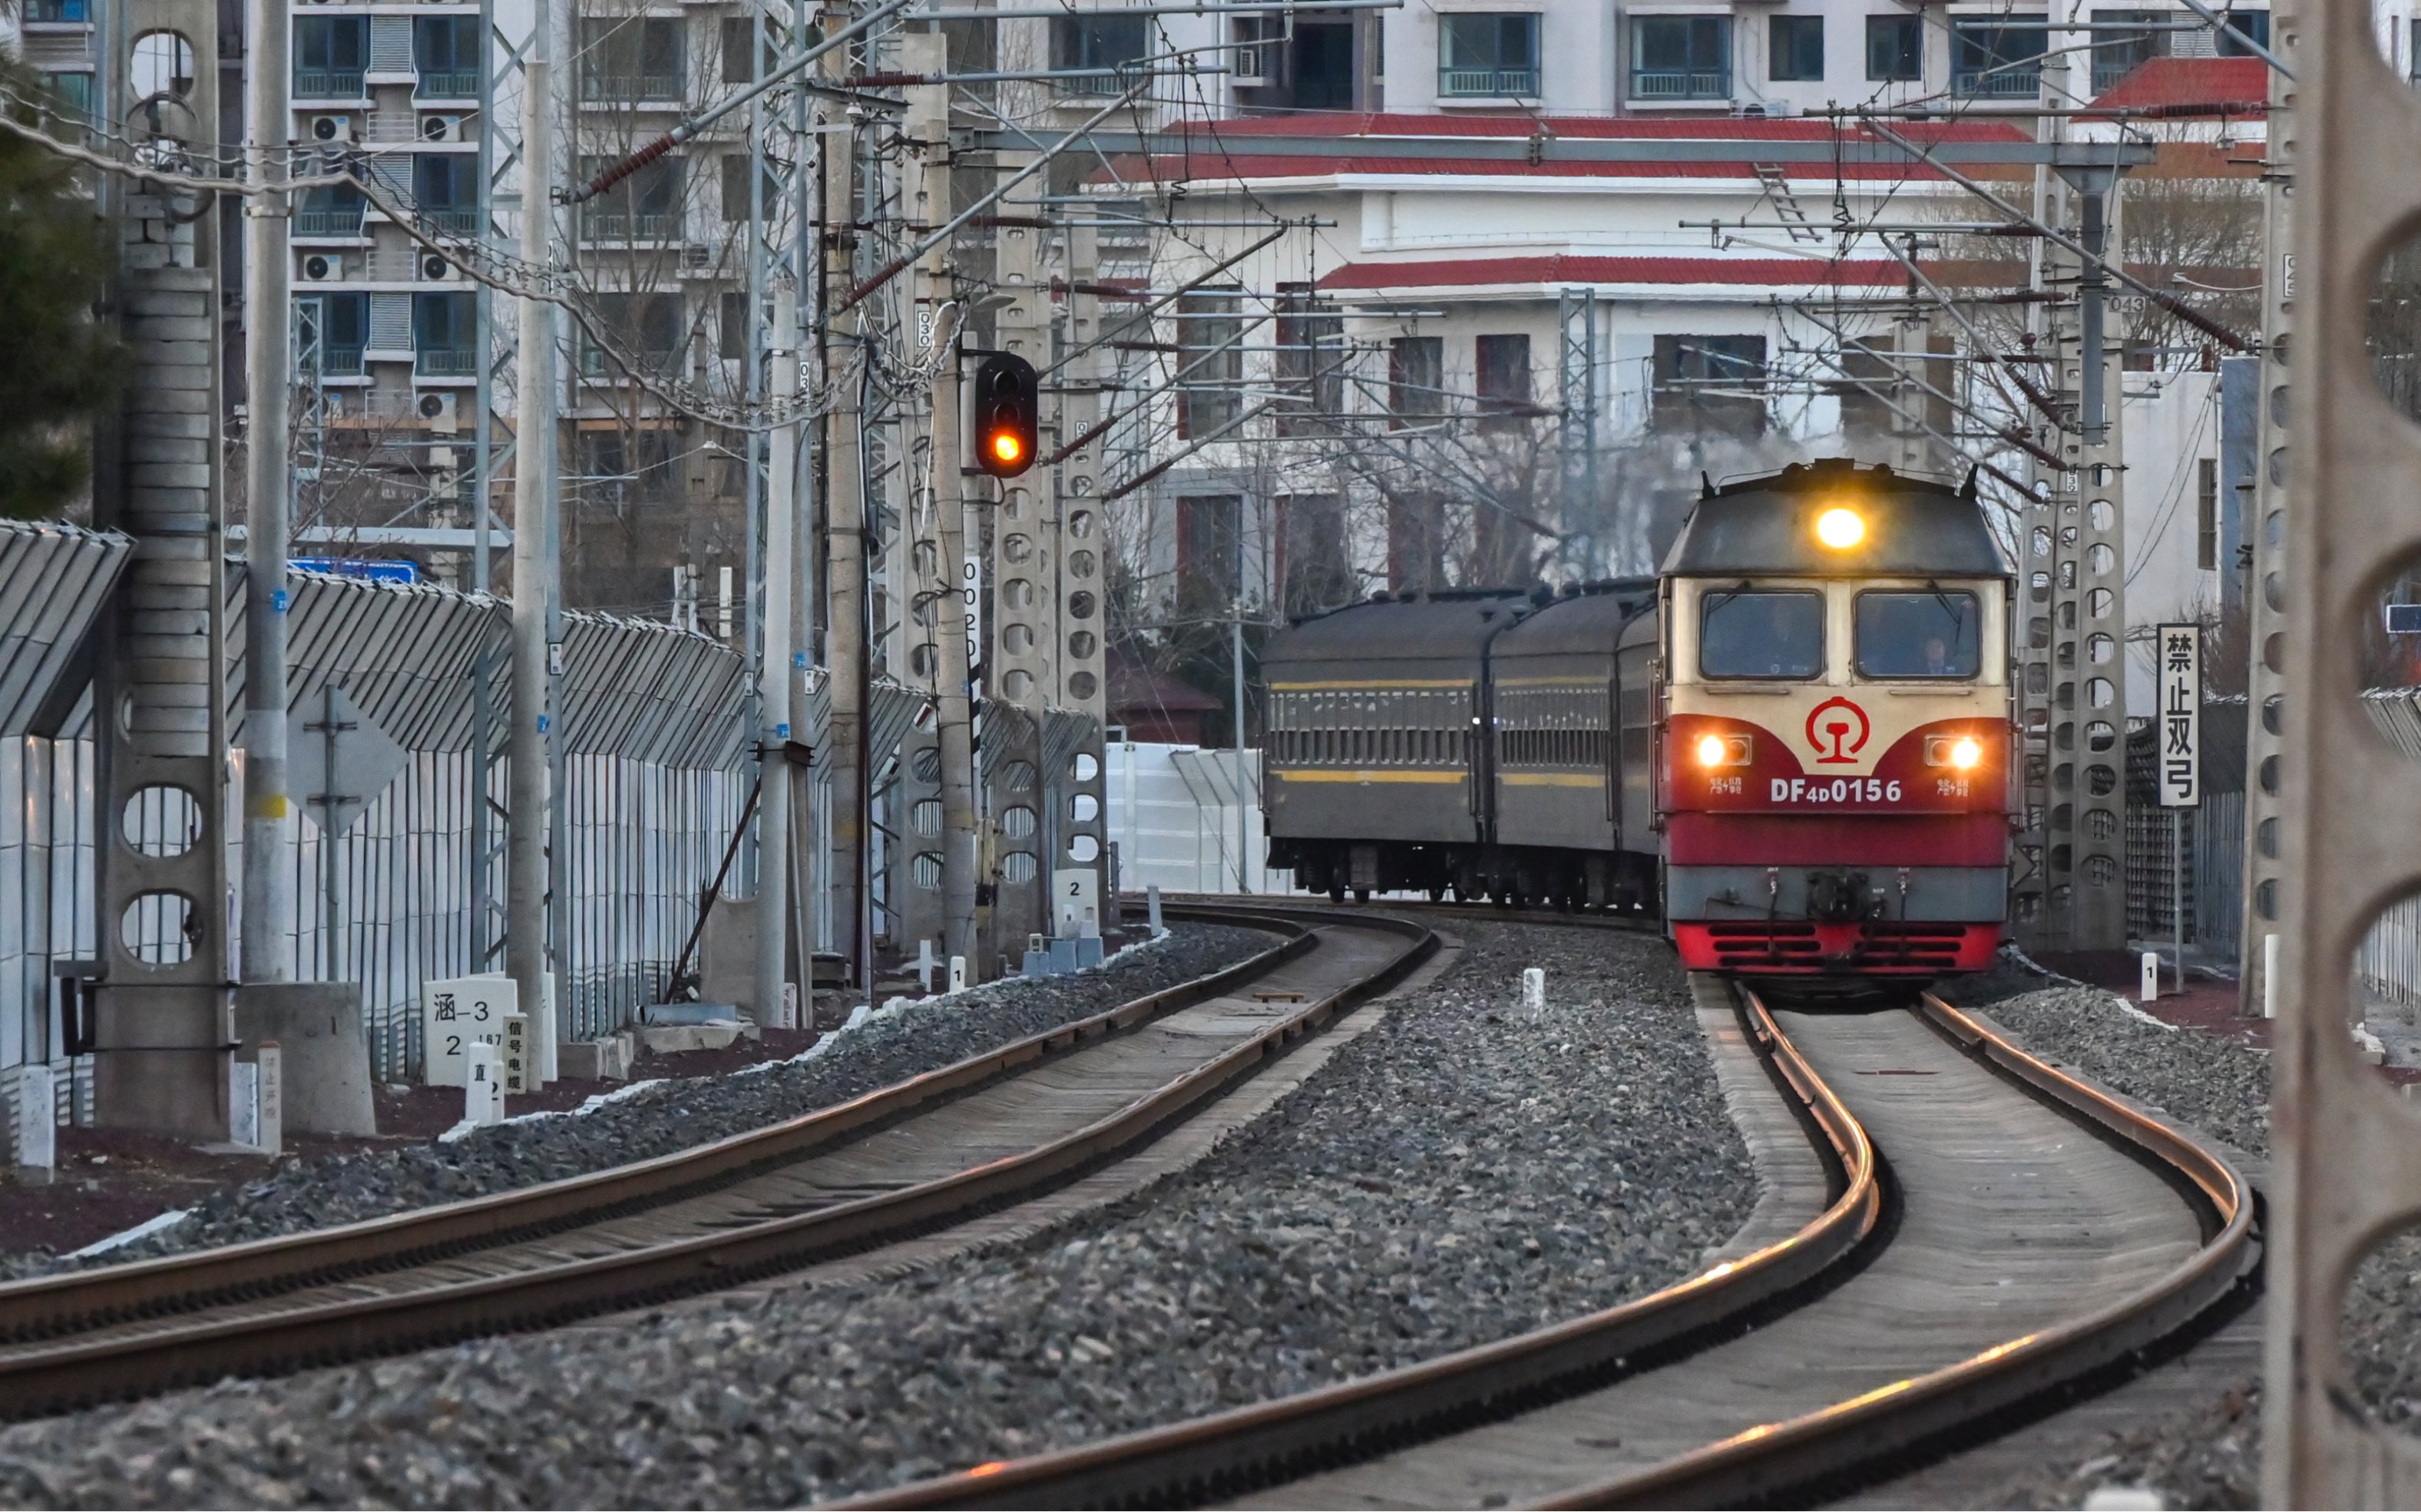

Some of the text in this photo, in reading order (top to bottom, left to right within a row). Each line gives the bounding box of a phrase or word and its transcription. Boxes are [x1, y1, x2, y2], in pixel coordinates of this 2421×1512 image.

[2112, 297, 2145, 311] 043
[921, 313, 930, 345] 030
[964, 563, 976, 656] 0020
[2166, 634, 2193, 799] 禁止双弓
[1771, 779, 1901, 802] DF4D0156
[1070, 882, 1080, 896] 2
[954, 970, 960, 981] 1
[2146, 966, 2152, 978] 1
[446, 1036, 461, 1055] 2
[508, 1021, 522, 1090] 信号电缆
[475, 1064, 486, 1081] 直
